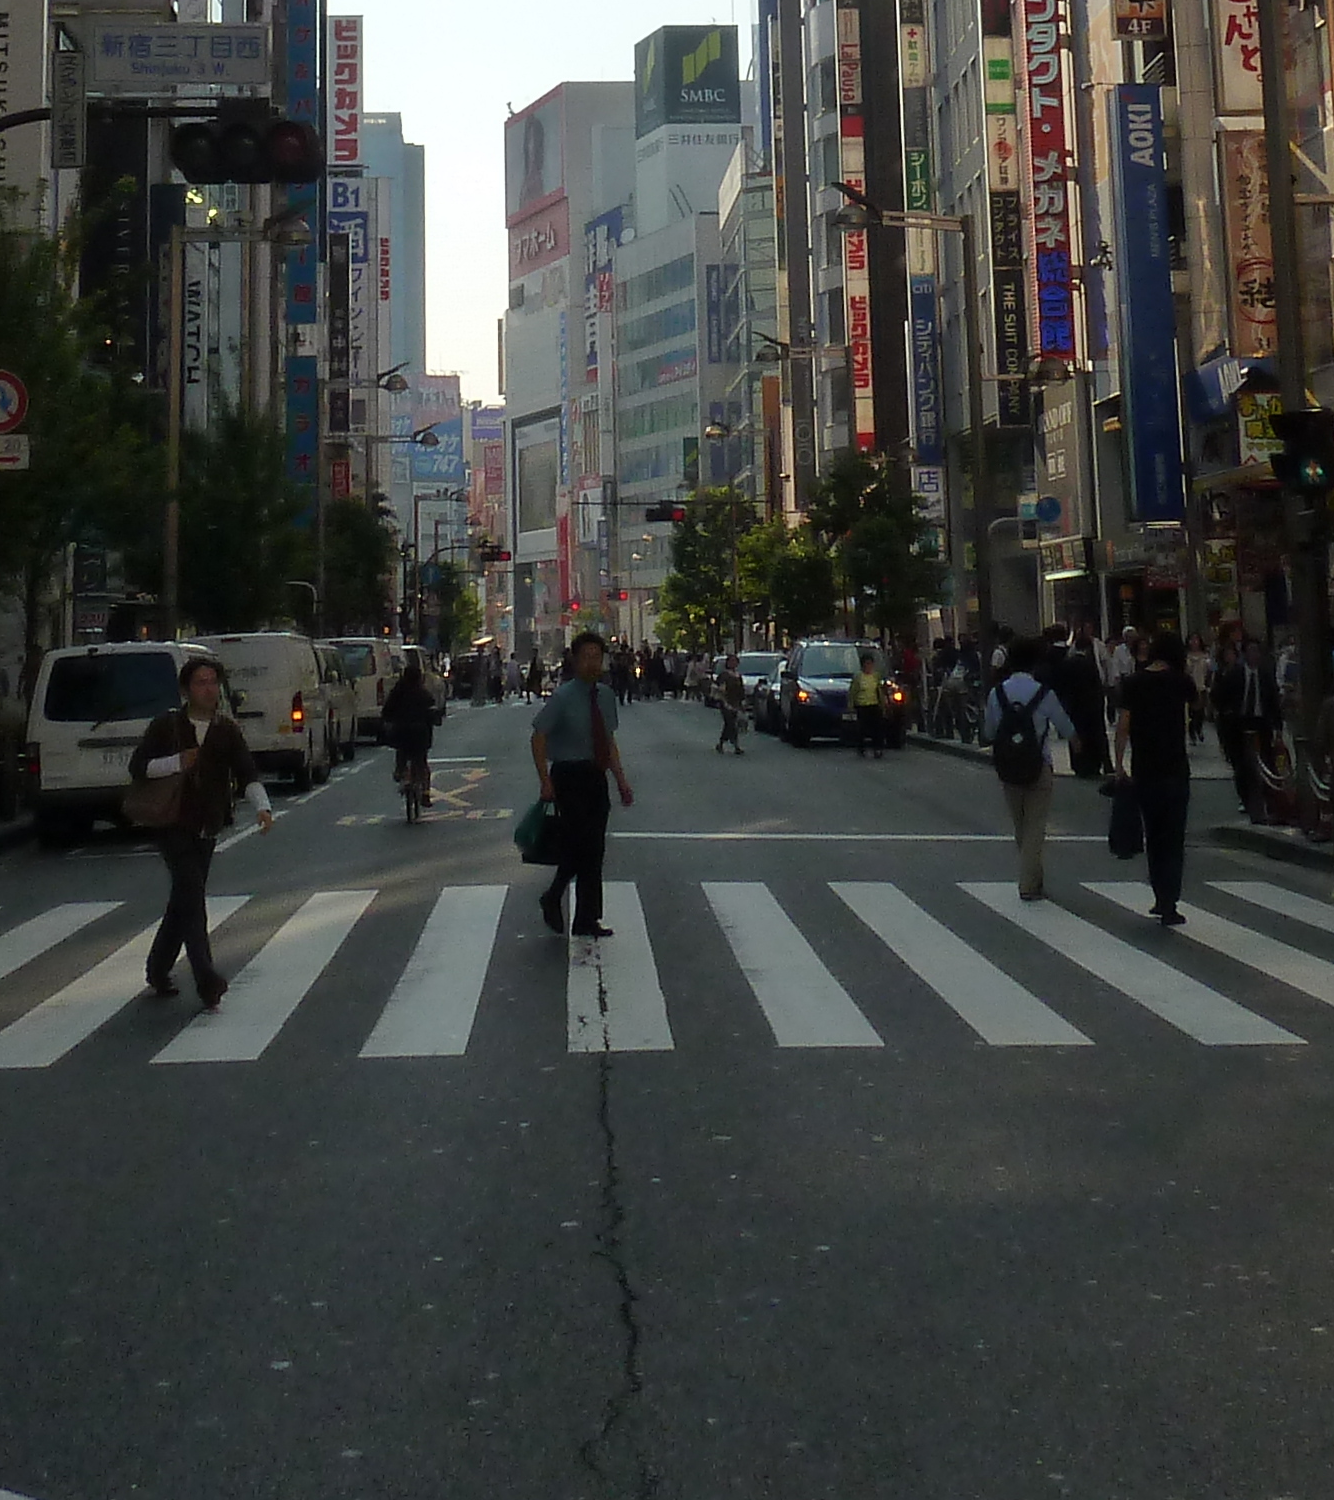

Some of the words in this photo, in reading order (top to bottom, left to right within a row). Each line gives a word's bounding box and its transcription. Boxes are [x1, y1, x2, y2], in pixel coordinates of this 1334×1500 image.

[1127, 18, 1153, 35] 4F
[102, 33, 261, 59] 新宿三丁目西
[679, 88, 726, 102] SMBC
[1128, 103, 1155, 168] AOKI
[332, 182, 360, 208] B1
[1002, 282, 1015, 308] THE
[186, 280, 202, 384] WATCH
[1004, 308, 1016, 338] SUIT
